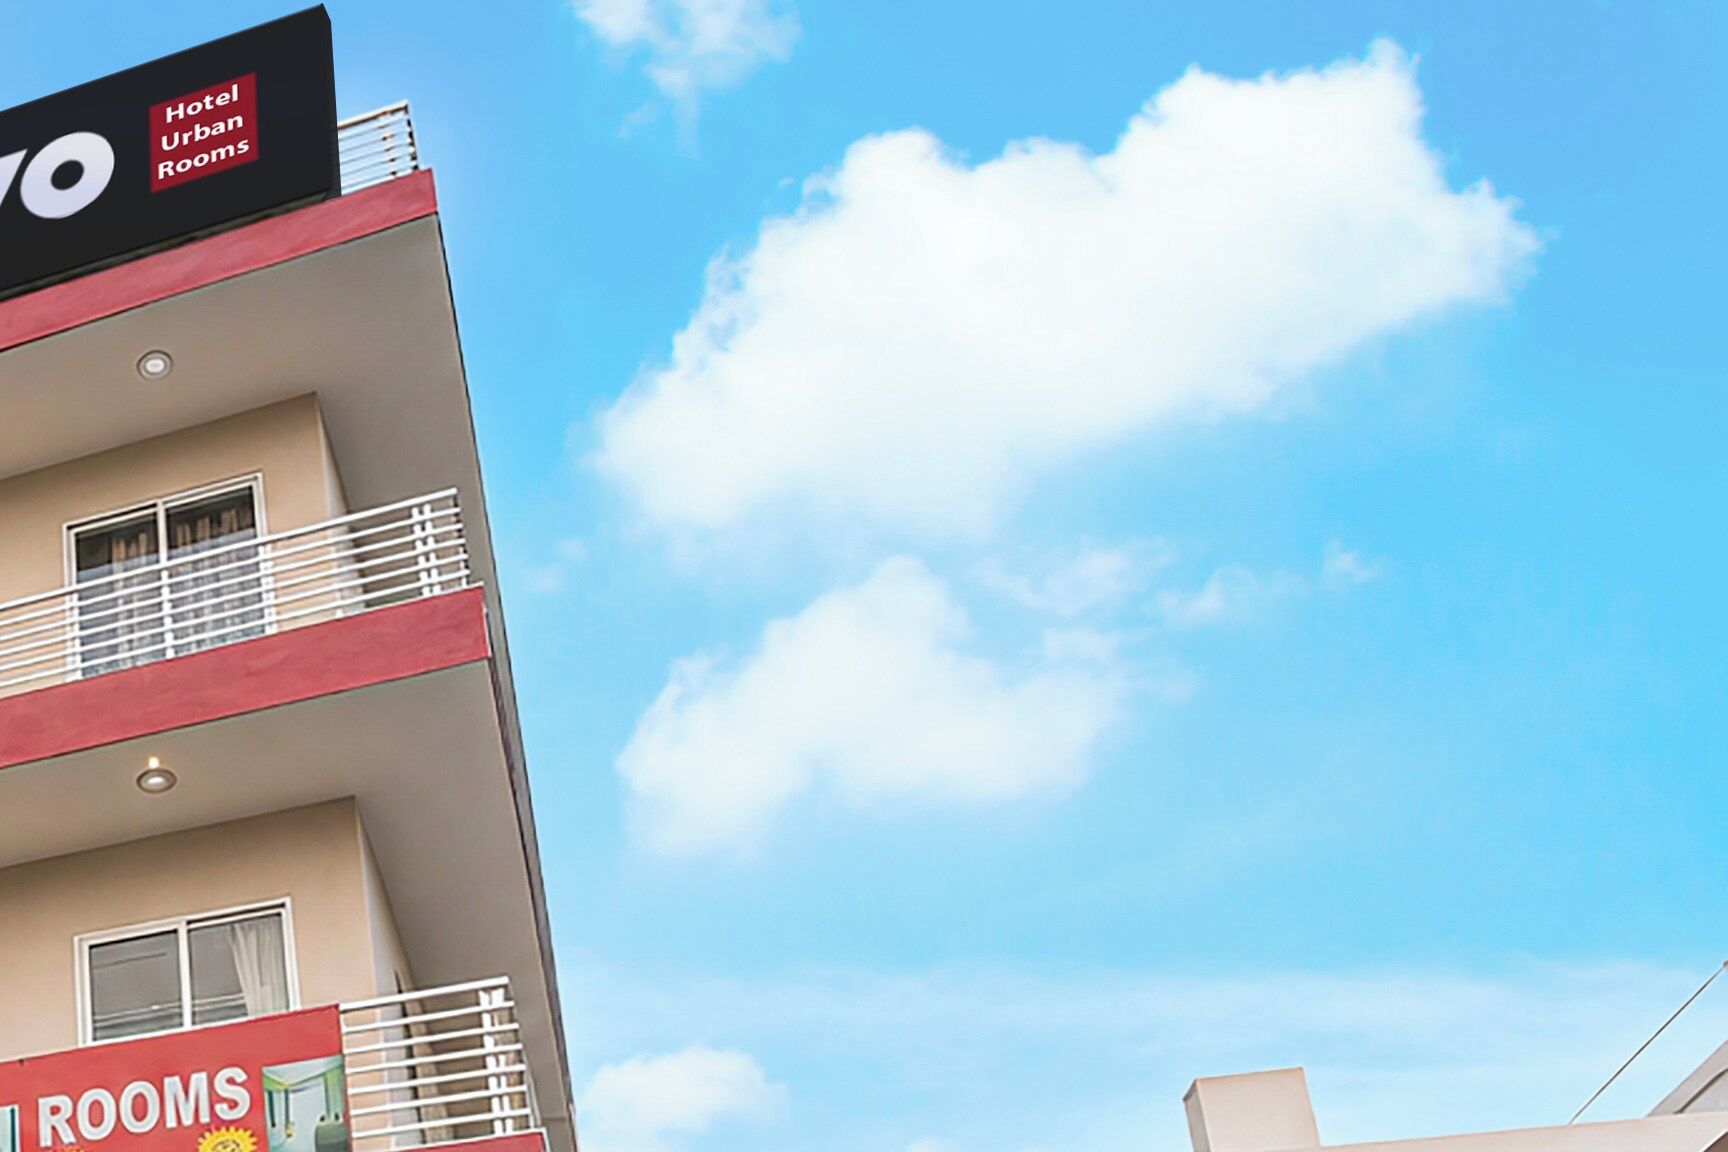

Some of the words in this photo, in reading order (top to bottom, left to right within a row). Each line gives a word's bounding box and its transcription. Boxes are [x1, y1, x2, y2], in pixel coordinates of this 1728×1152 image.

[165, 83, 239, 124] Hotel
[161, 115, 243, 151] Urban
[158, 139, 250, 180] Rooms
[38, 1067, 251, 1148] ROOMS
